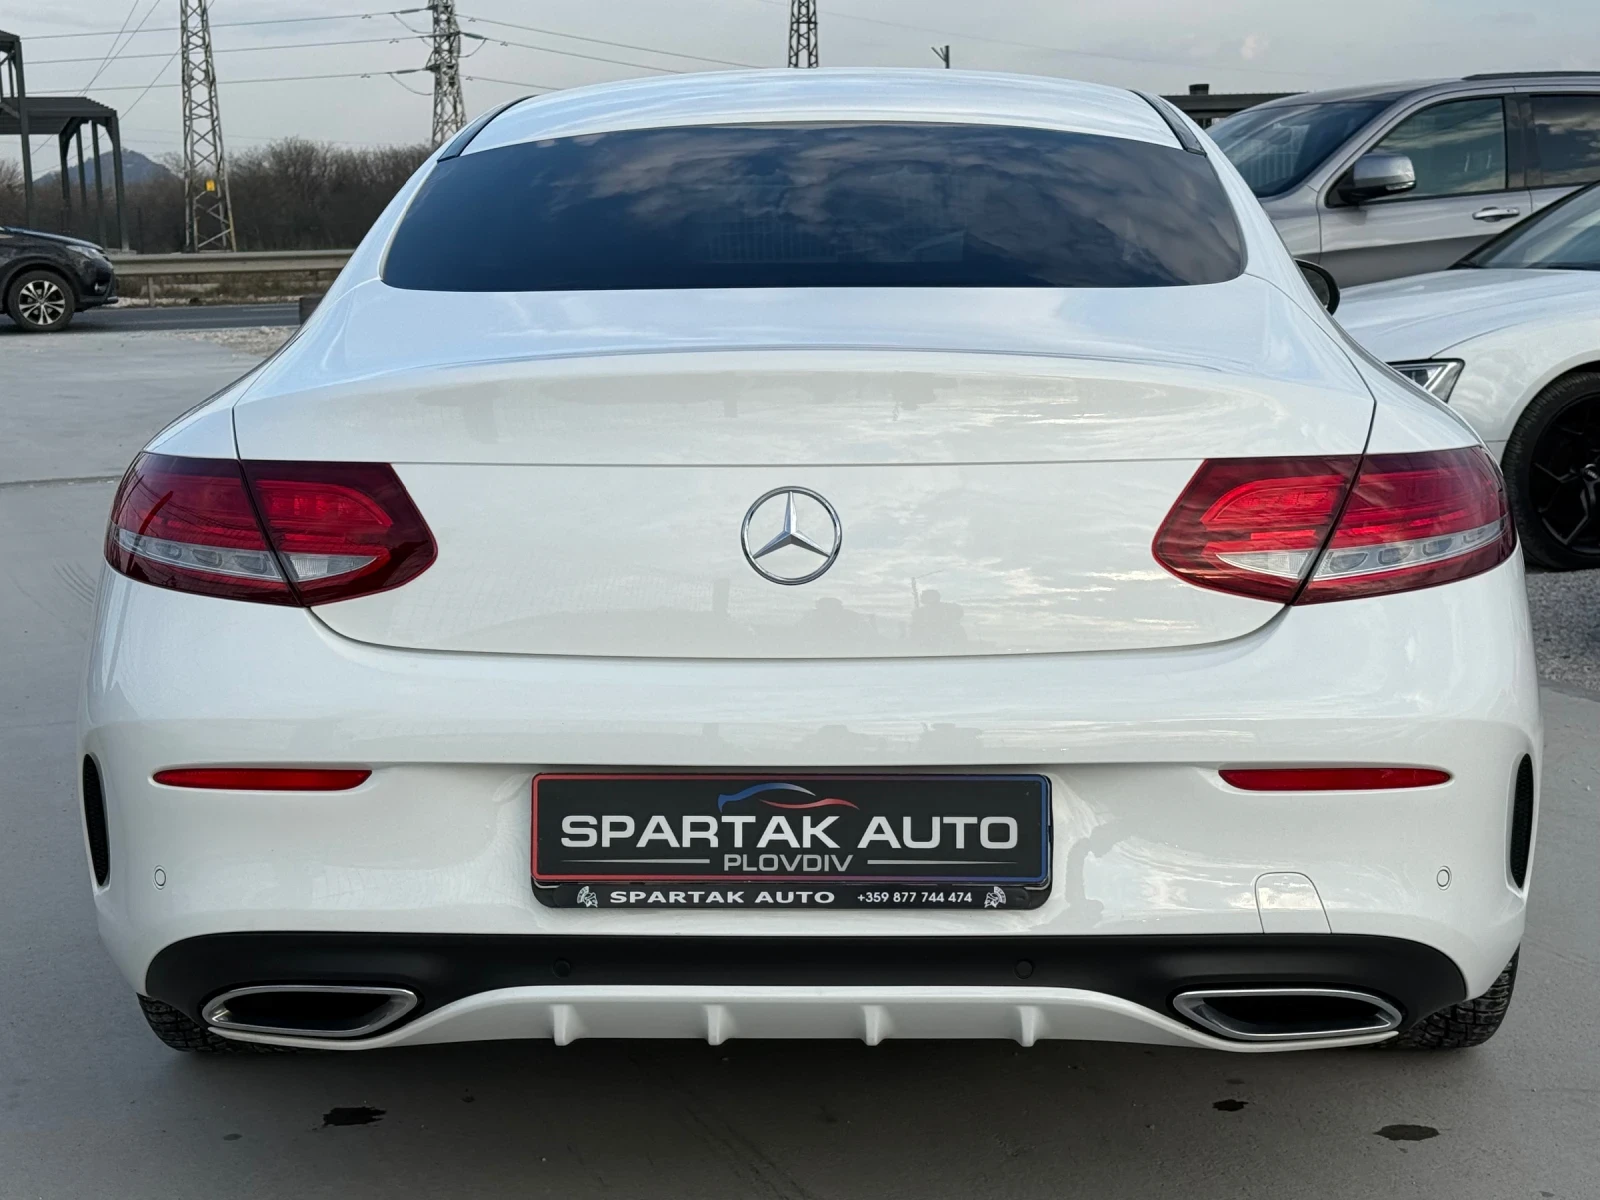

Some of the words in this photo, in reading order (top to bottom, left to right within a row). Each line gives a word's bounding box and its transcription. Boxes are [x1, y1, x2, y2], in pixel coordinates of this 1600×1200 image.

[560, 815, 841, 849] SPARTAK
[857, 815, 1018, 850] AUTO
[723, 853, 854, 872] PLOVDIV
[609, 890, 745, 904] SPARTAK
[754, 890, 835, 904] AUTO
[857, 891, 890, 903] +359
[892, 891, 917, 903] 877
[921, 891, 945, 903] 744
[947, 891, 973, 903] 474
